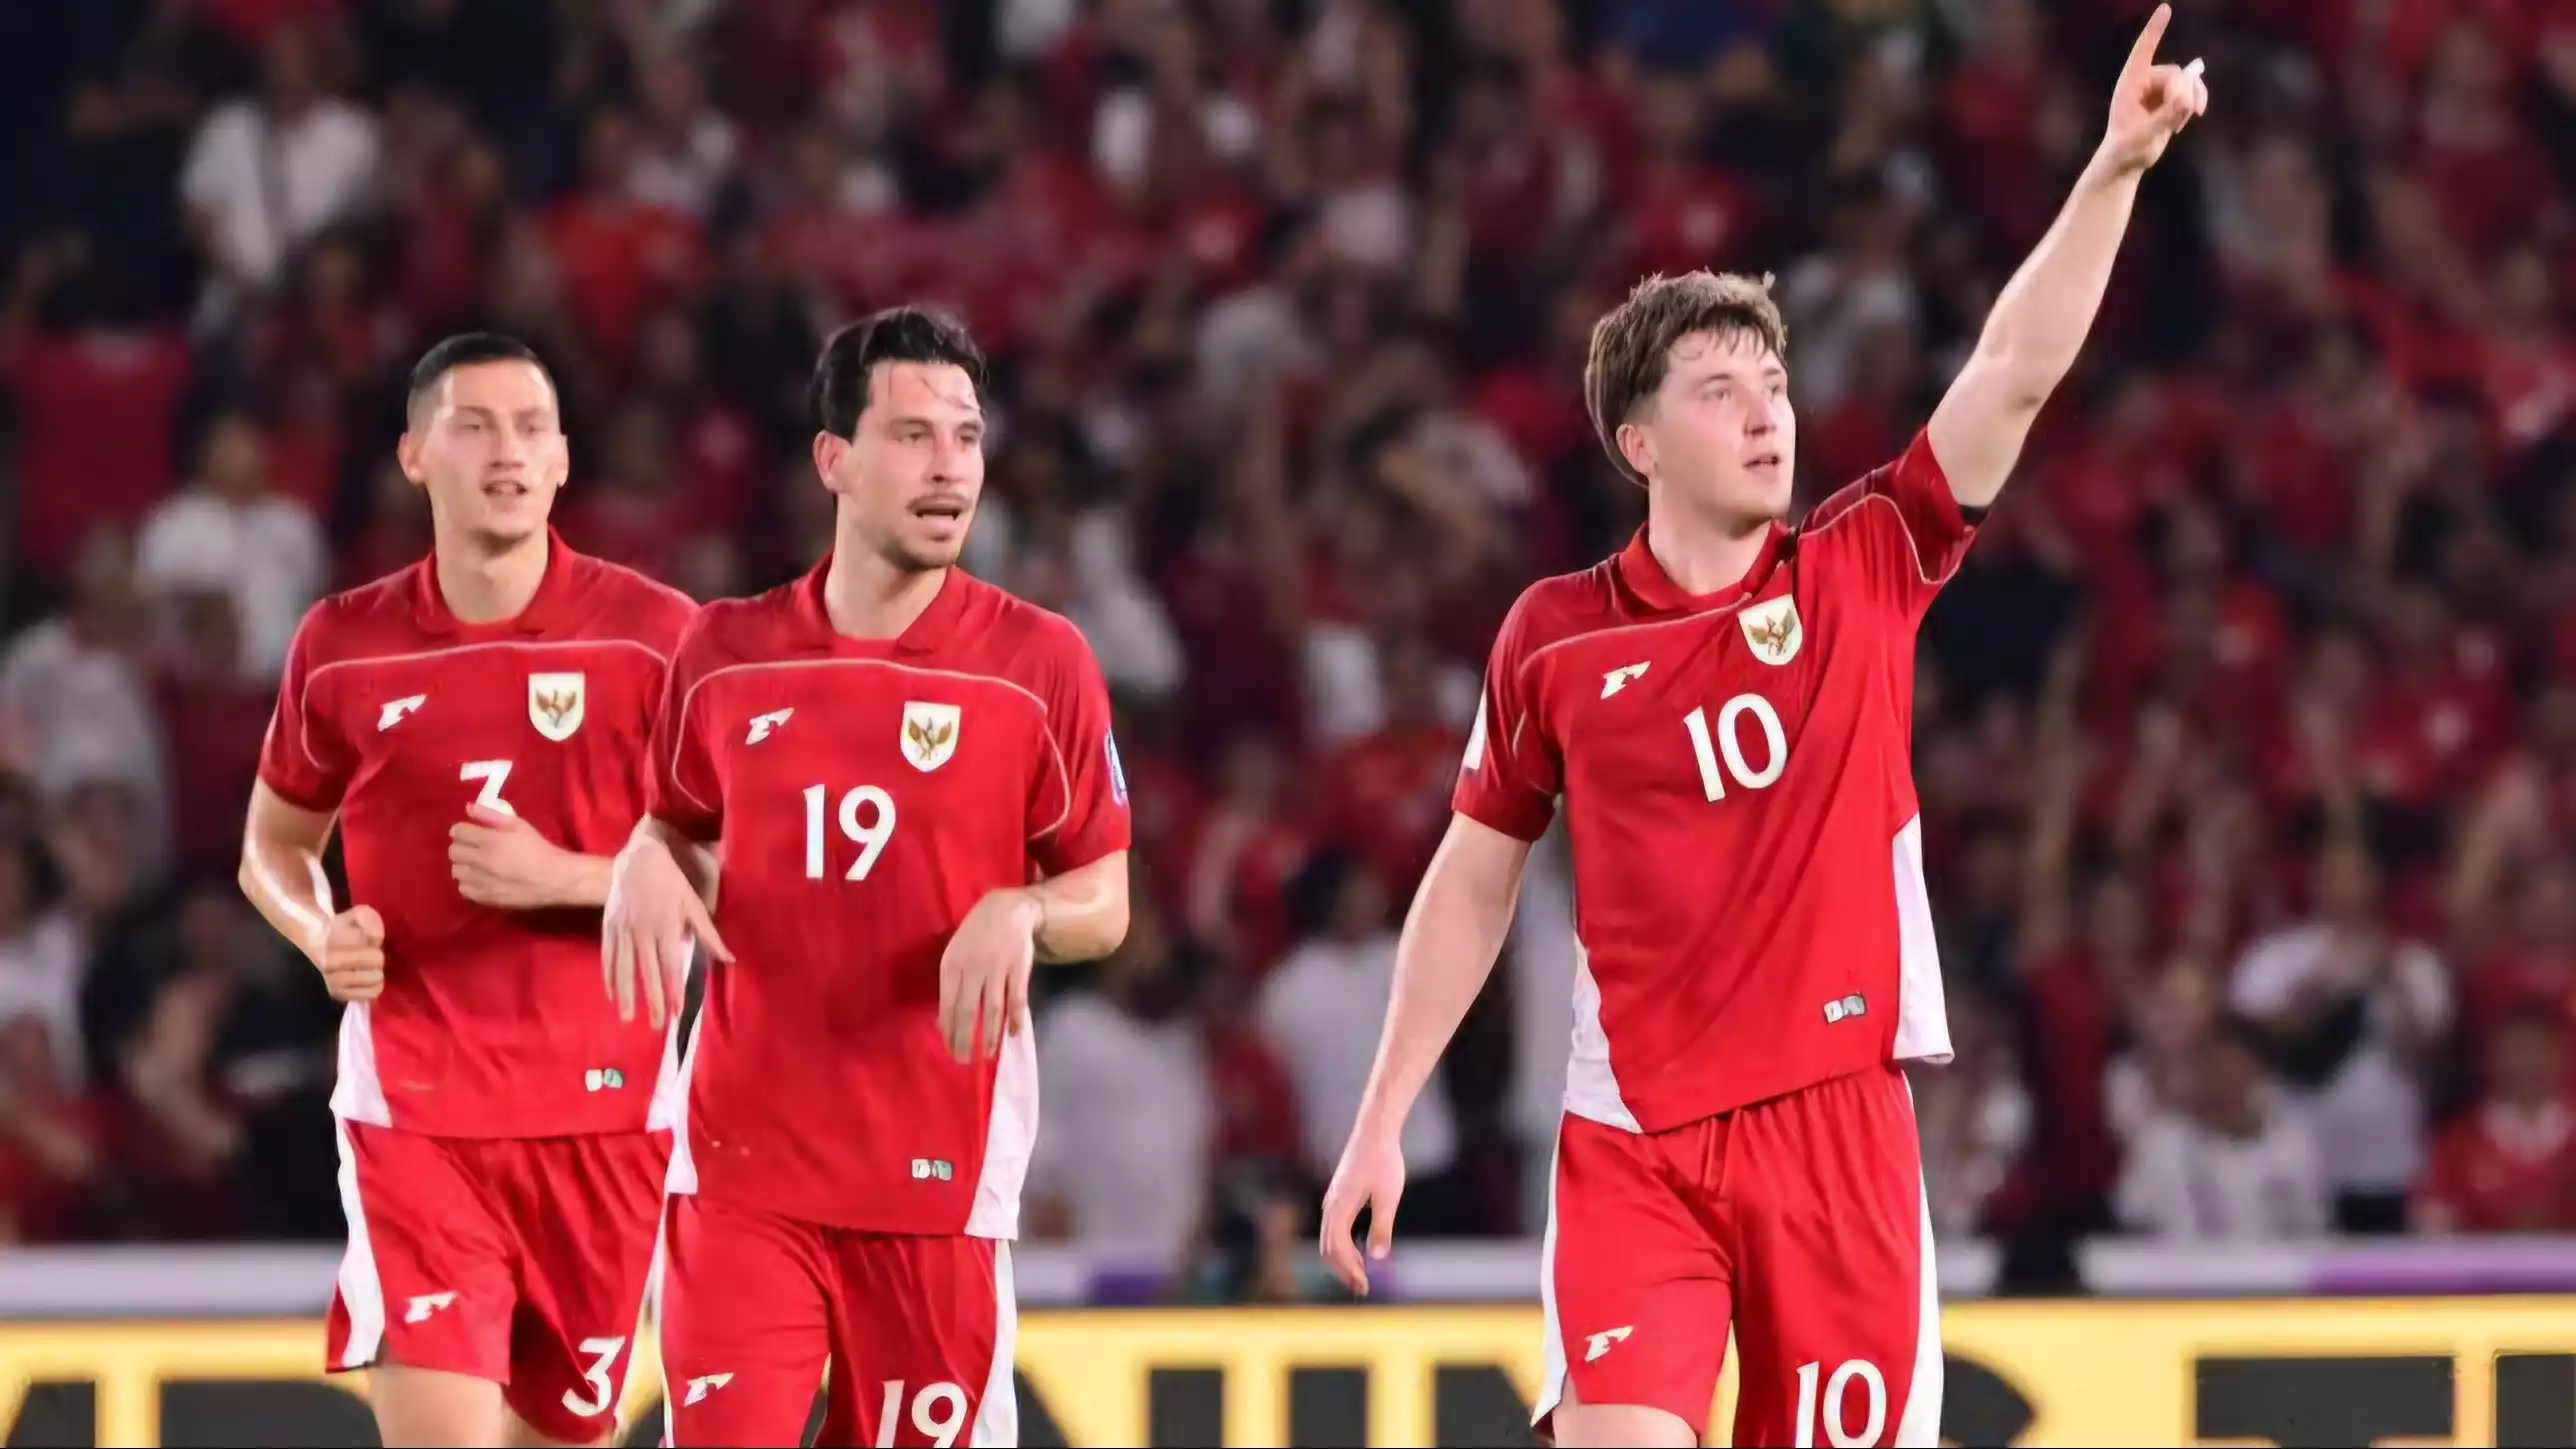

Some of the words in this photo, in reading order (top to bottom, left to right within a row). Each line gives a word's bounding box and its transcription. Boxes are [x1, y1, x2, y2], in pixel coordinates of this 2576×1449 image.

[1683, 693, 1788, 802] 10
[803, 784, 896, 880] 19
[562, 1336, 625, 1417] 3
[875, 1379, 968, 1448] 19
[1795, 1359, 1886, 1448] 10
